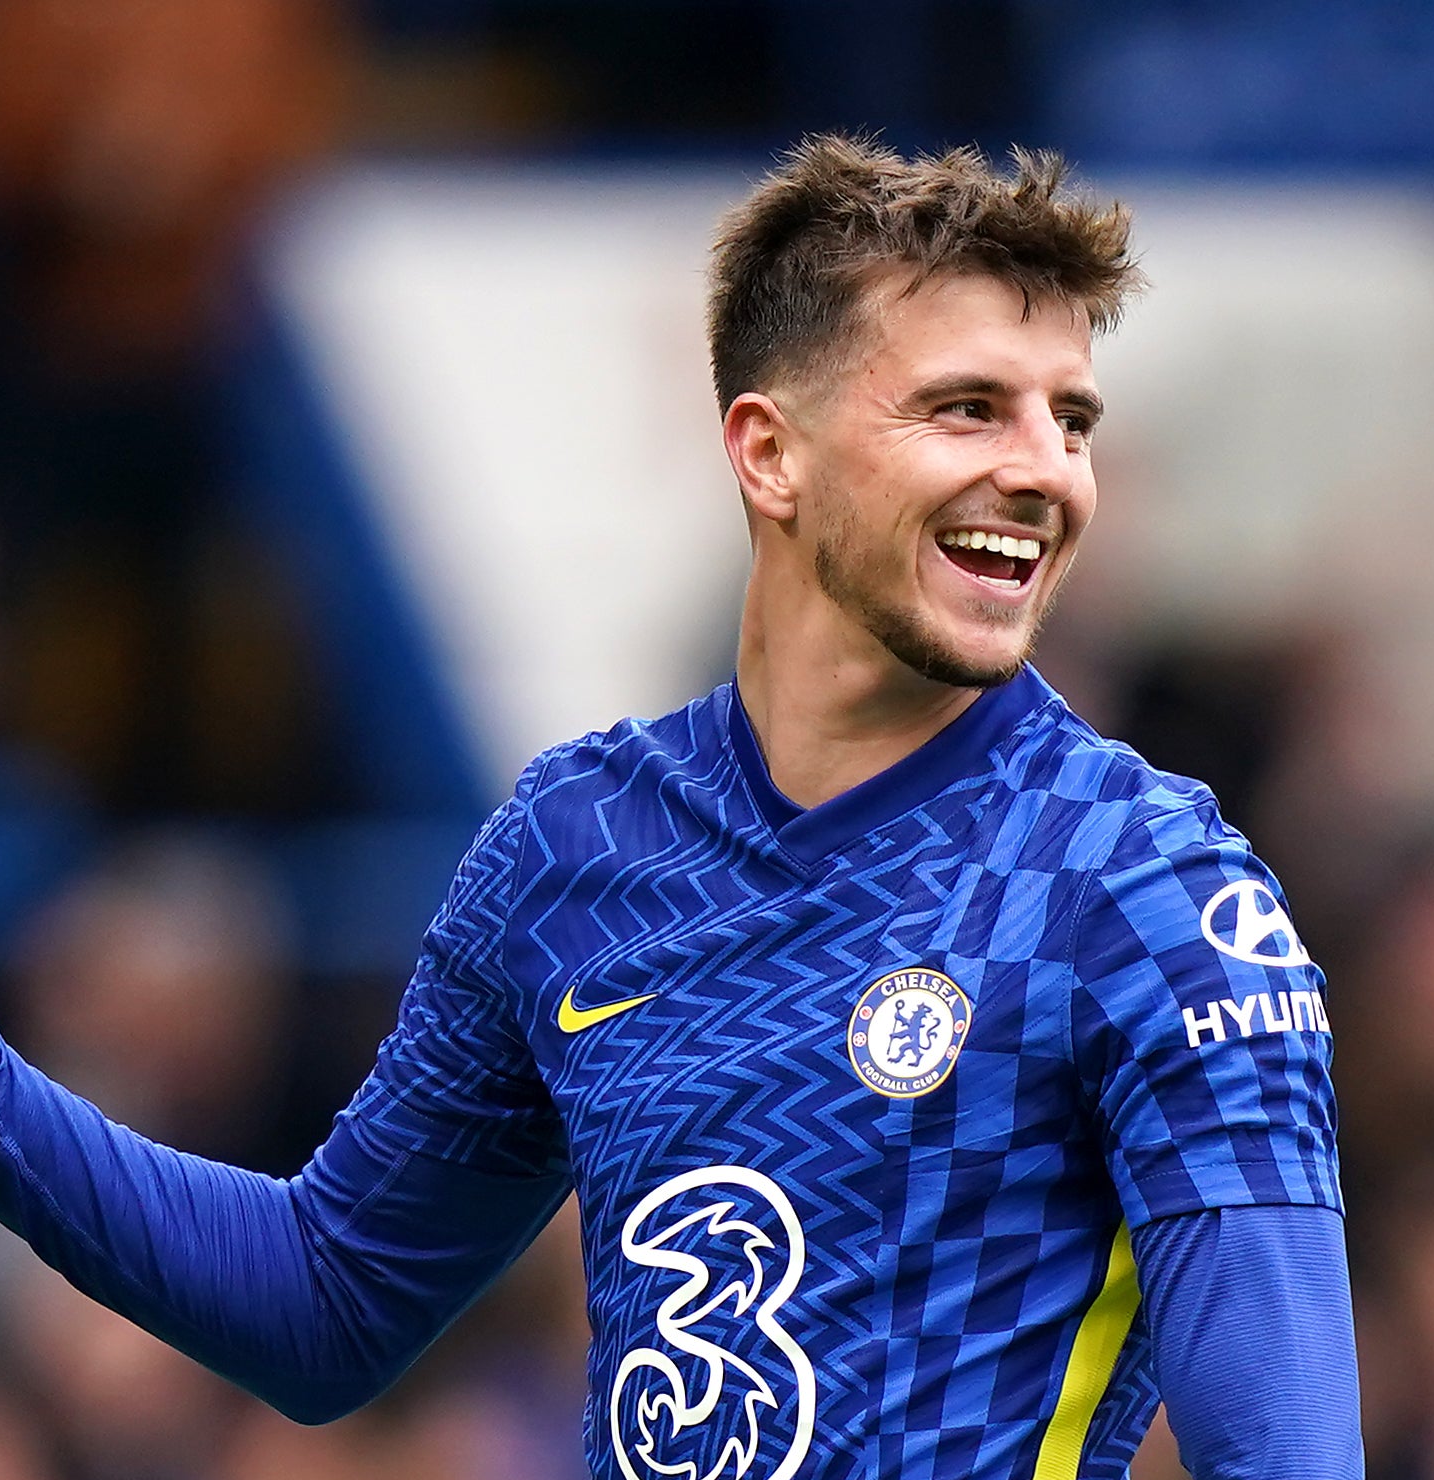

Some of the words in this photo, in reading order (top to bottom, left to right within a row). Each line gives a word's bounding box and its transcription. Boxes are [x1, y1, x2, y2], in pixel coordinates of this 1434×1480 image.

[880, 973, 960, 1008] CHELSEA
[861, 1061, 909, 1091] FOOTBALL
[912, 1070, 940, 1089] CLUB
